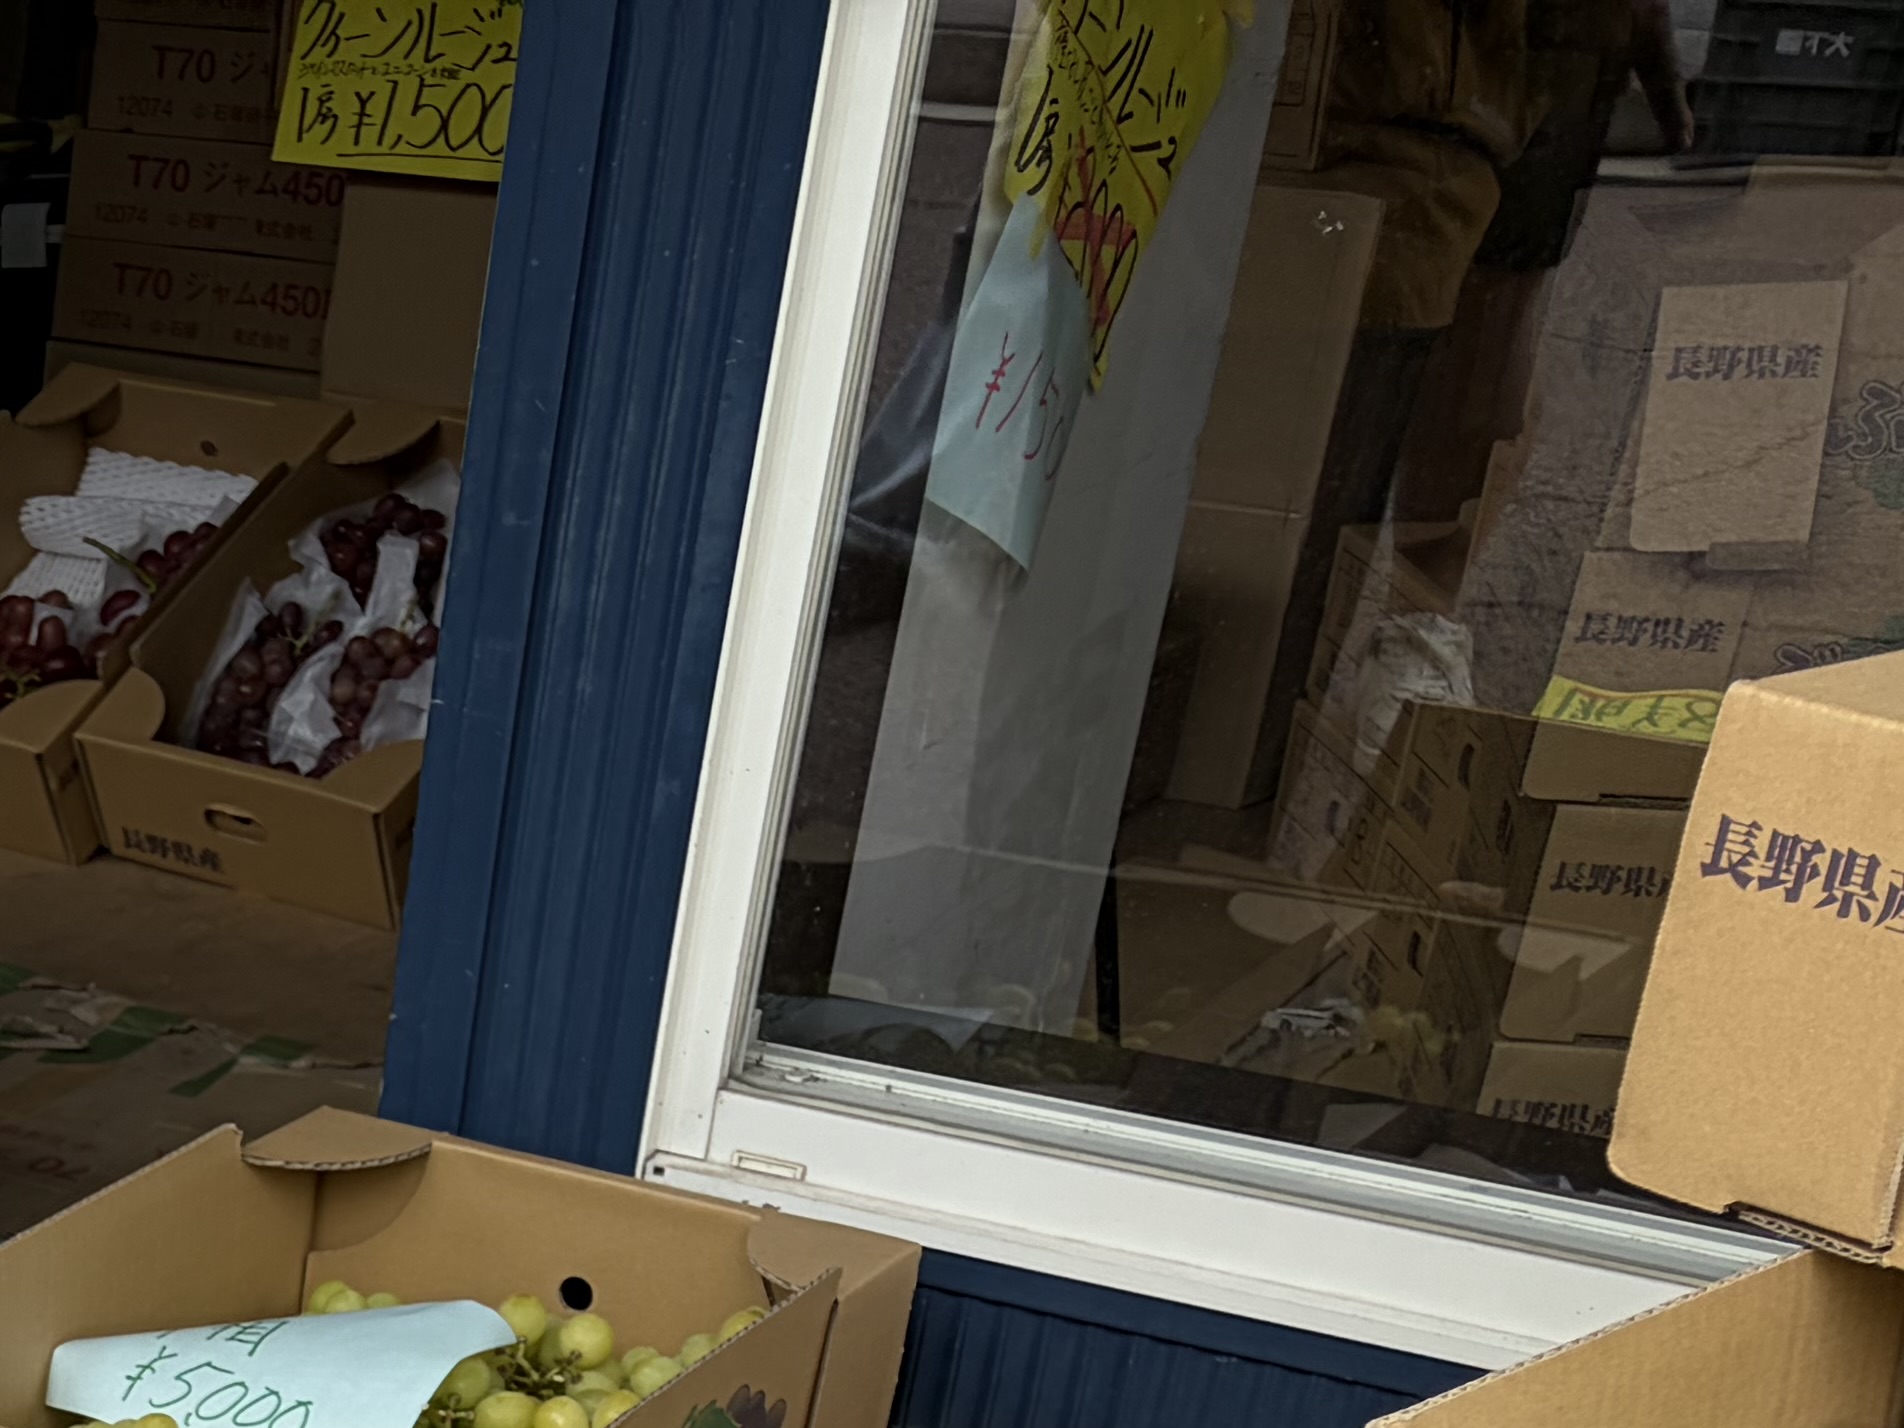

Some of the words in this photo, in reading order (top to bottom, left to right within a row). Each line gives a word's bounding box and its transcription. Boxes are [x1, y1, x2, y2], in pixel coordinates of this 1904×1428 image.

[127, 154, 190, 191] T70
[113, 262, 174, 300] T70
[1665, 341, 1824, 384] 長野県産
[1575, 612, 1725, 652] 長野県産
